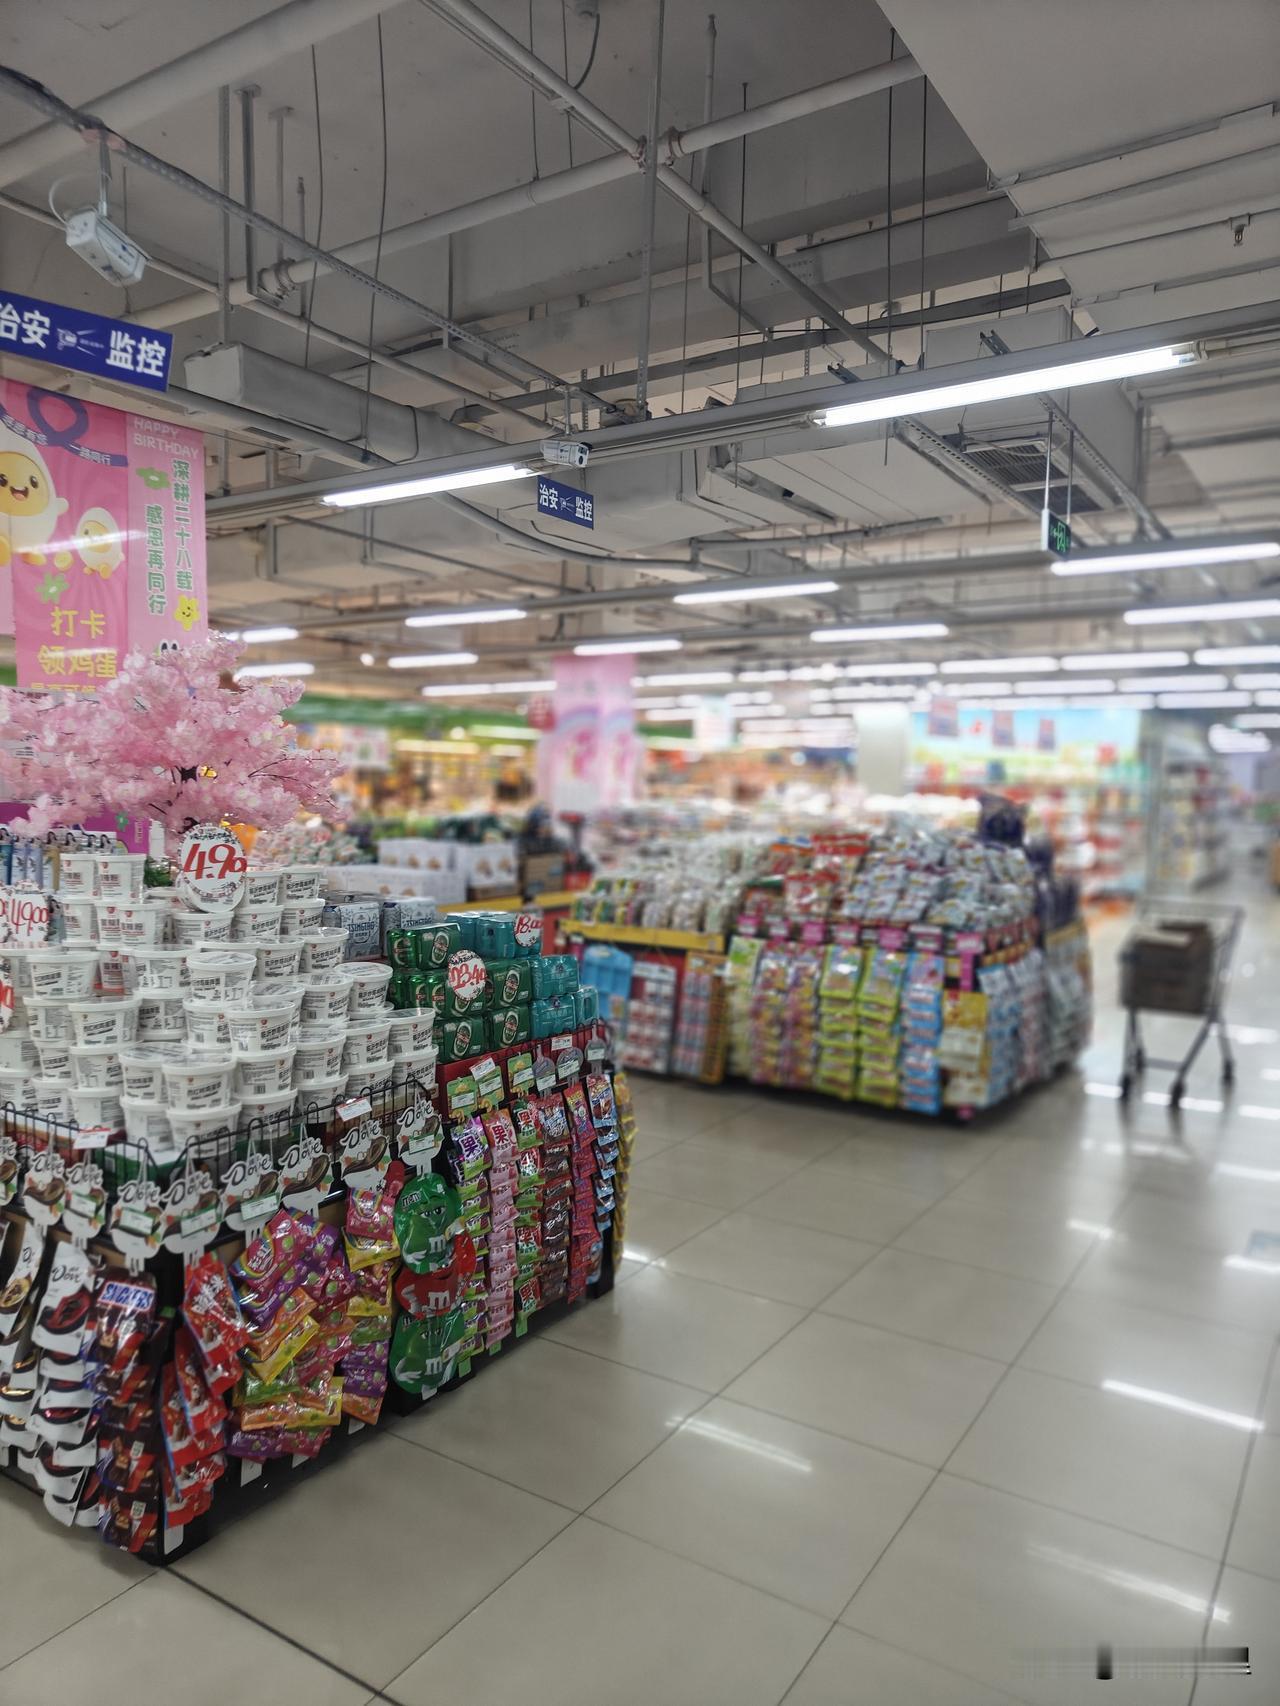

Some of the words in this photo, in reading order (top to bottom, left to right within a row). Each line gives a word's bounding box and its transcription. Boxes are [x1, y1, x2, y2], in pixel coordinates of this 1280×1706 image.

[105, 329, 166, 378] 监控
[133, 416, 179, 439] HAPPY
[133, 433, 200, 460] BIRTHDAY
[539, 483, 559, 510] 治安
[575, 496, 593, 521] 监控
[50, 606, 106, 640] 打卡
[38, 644, 117, 679] 领鸡蛋
[398, 1106, 433, 1128] Dove
[340, 1124, 380, 1149] Dove
[460, 1136, 481, 1158] 果
[491, 1125, 510, 1144] 果
[278, 1141, 322, 1169] Dove
[222, 1157, 271, 1187] Dove
[162, 1175, 210, 1206] Dove
[52, 1265, 82, 1283] Dove
[428, 1291, 450, 1310] m
